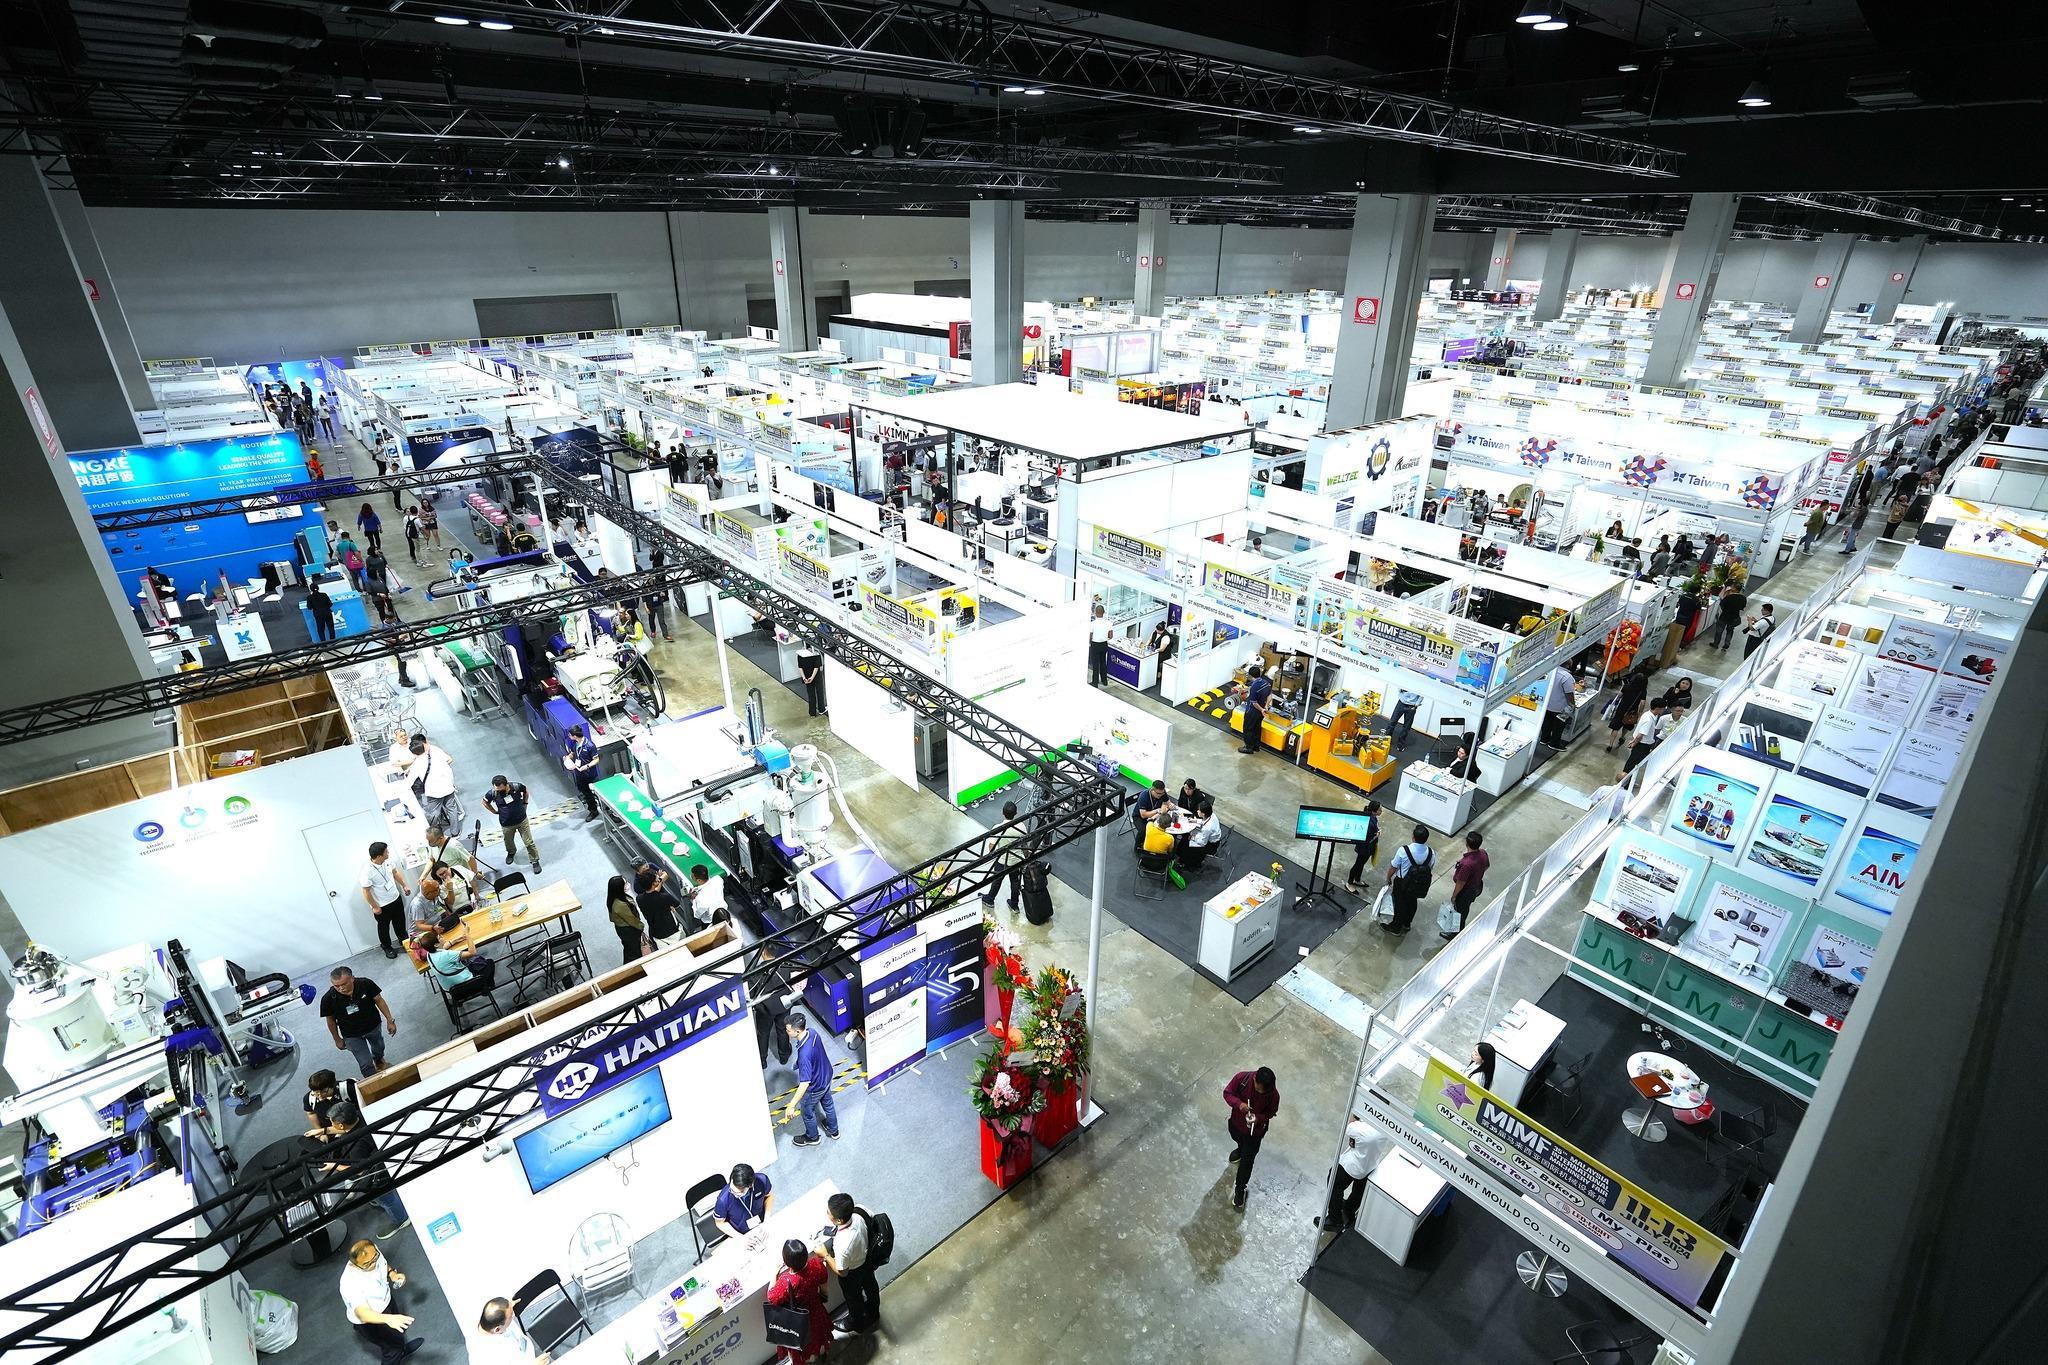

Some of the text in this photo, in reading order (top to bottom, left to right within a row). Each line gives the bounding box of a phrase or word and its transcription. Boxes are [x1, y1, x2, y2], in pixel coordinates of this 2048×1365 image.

[415, 434, 443, 444] tederic
[879, 425, 910, 443] LKIMM
[1478, 436, 1512, 451] Taiwan
[69, 456, 131, 474] NGKE
[218, 461, 245, 471] LEADING
[260, 456, 287, 466] WORLD
[1576, 454, 1612, 470] Taiwan
[249, 473, 293, 484] PRECIPITATION
[1688, 474, 1731, 491] Taiwan
[92, 491, 190, 509] PLASTIC WELDING SOLUTIONS
[1145, 546, 1162, 558] 11-13
[1271, 588, 1292, 602] 11-13
[909, 612, 925, 628] 11-13
[1371, 620, 1454, 656] MIMF 11-13
[1328, 650, 1359, 665] INSTRUMENTS
[1359, 660, 1369, 668] SDN
[1369, 664, 1380, 673] BHD
[1418, 653, 1446, 667] My Plas
[1917, 741, 1942, 752] Extru
[1704, 792, 1733, 807] APPLICATION
[1850, 875, 1869, 886] Acrylic
[1869, 883, 1889, 894] Impact
[953, 911, 977, 925] HAITIAN
[937, 949, 949, 957] NEXT
[949, 937, 978, 952] GENERATION
[947, 956, 981, 992] 5
[258, 1008, 285, 1020] HAITIAN
[602, 988, 743, 1075] HAITIAN
[556, 1066, 589, 1093] HT
[1440, 1105, 1457, 1120] My
[1460, 1119, 1485, 1141] Pack
[1485, 1136, 1503, 1153] Pro
[1483, 1102, 1553, 1156] MIMF
[549, 1139, 575, 1154] LOBAL
[1472, 1143, 1537, 1191] Smart Tech
[1551, 1150, 1610, 1193] INTERNATIONAL
[1570, 1155, 1610, 1186] MALAYSIA
[1363, 1102, 1403, 1135] TAIZHOU
[1402, 1130, 1459, 1175] HUANGYAN
[1459, 1171, 1481, 1190] JMT
[1481, 1187, 1521, 1219] MOULD
[1547, 1234, 1571, 1254] LTD
[1513, 1155, 1533, 1173] My
[1539, 1172, 1583, 1206] Bakery
[1549, 1156, 1609, 1198] MACHINERY FAIR
[1623, 1194, 1698, 1252] 11-13
[1597, 1211, 1624, 1233] My
[1635, 1237, 1673, 1266] Plas
[1619, 1212, 1692, 1260] JULY 2024
[684, 1316, 740, 1361] HAITIAN
